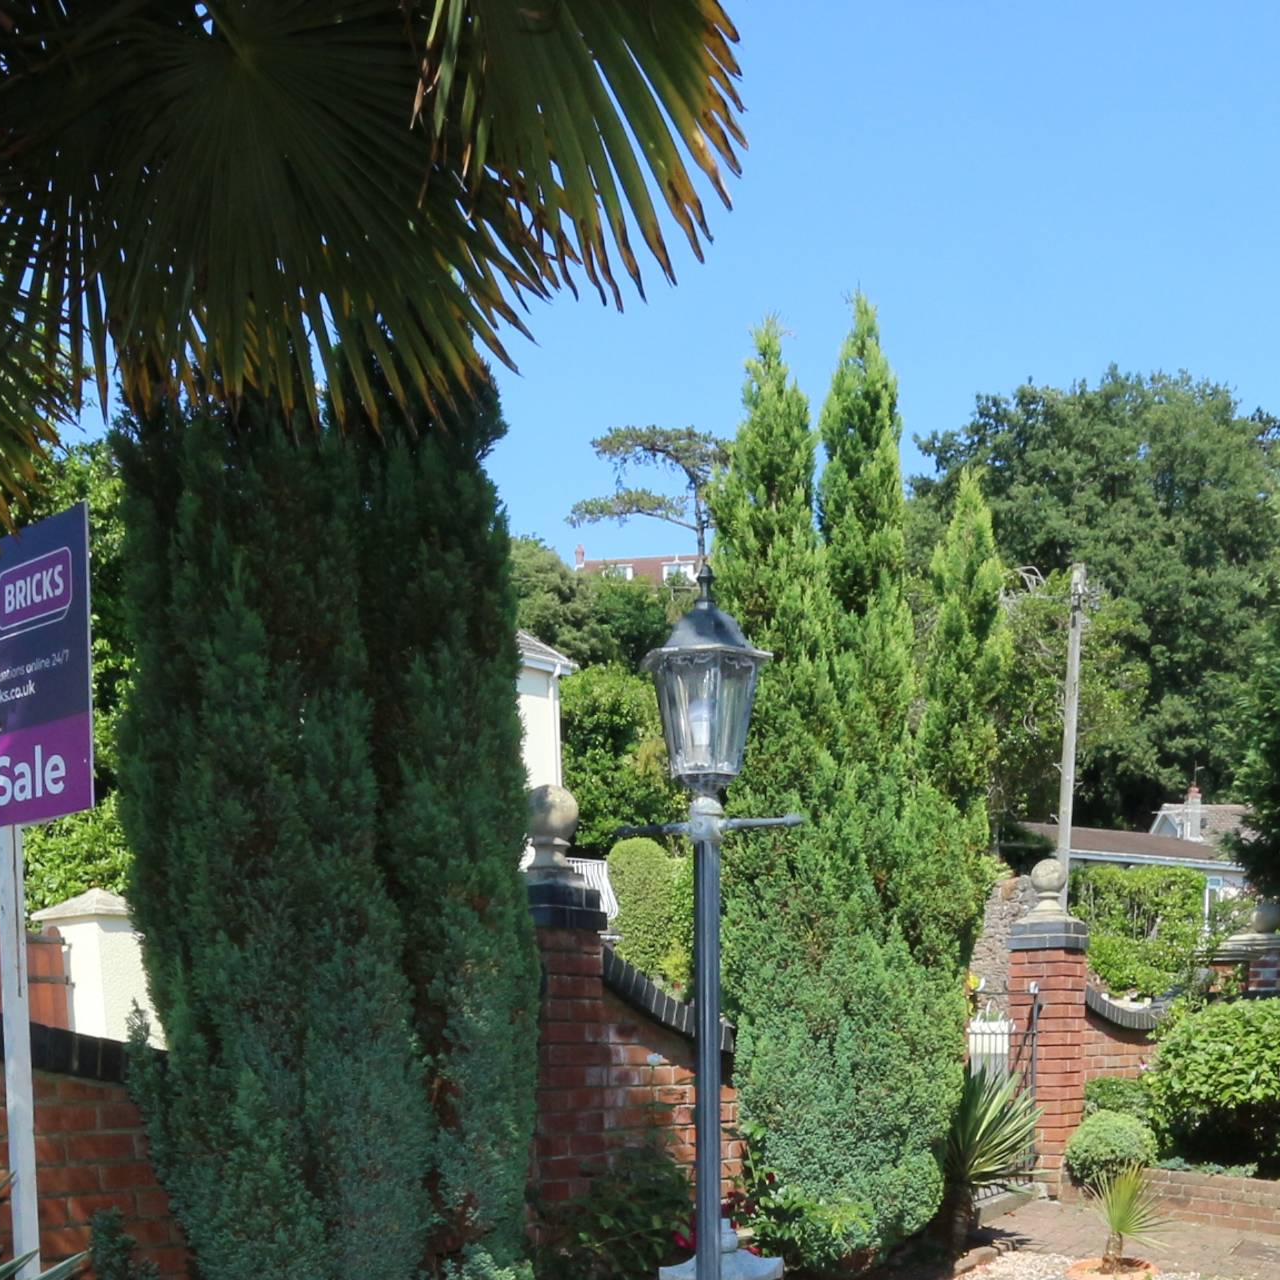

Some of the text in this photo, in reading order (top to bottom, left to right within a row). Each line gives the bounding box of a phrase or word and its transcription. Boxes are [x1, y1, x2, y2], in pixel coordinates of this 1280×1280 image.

[5, 564, 64, 614] BRICKS
[26, 657, 50, 673] online
[51, 648, 69, 666] 24/7
